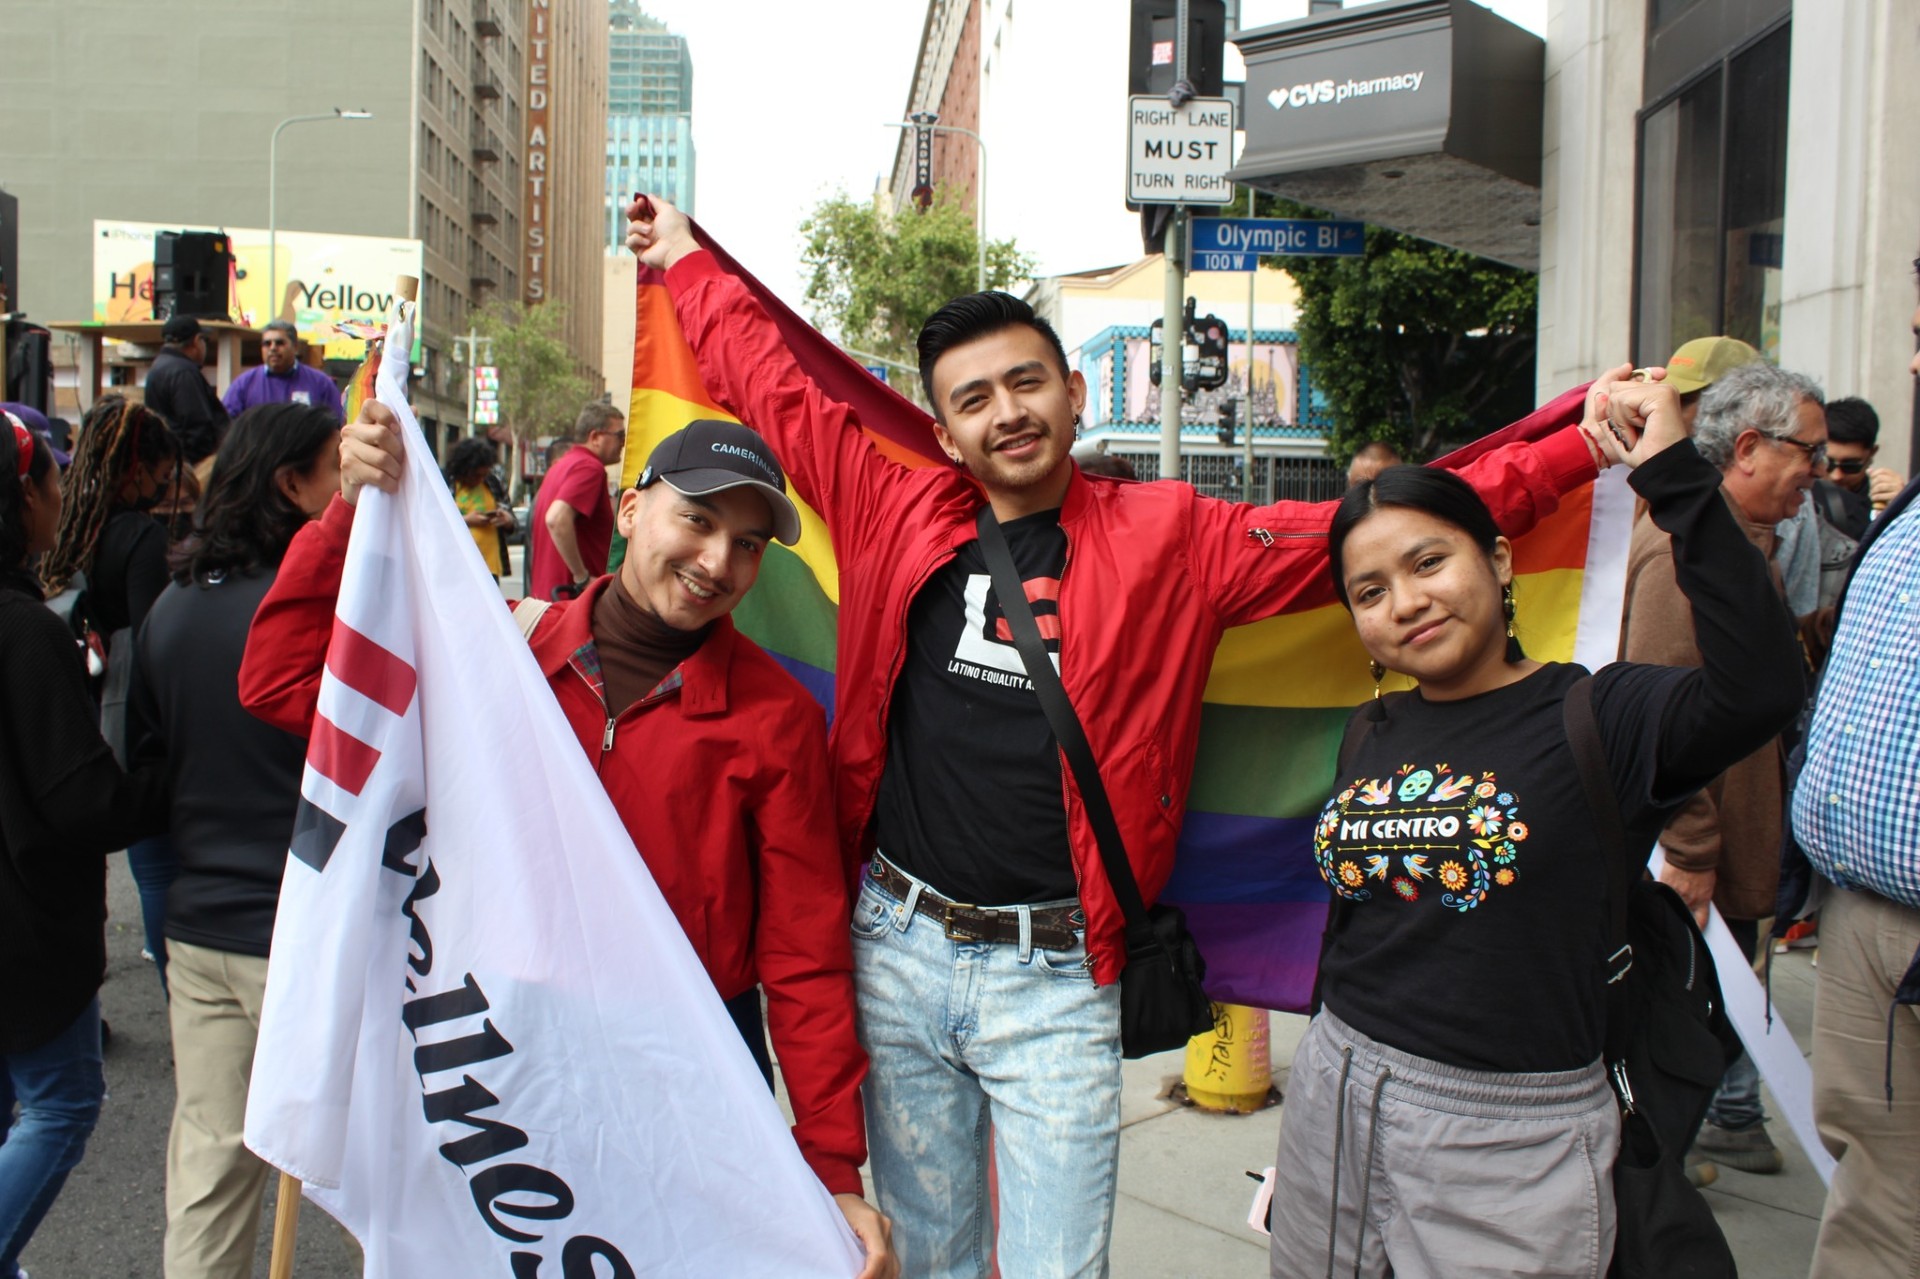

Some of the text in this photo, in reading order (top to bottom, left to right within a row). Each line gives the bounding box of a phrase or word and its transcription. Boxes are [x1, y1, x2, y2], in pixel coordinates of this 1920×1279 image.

[1289, 71, 1424, 107] CVS pharmacy
[1134, 111, 1229, 127] RIGHT LANE
[1145, 140, 1218, 160] MUST
[1134, 173, 1227, 189] TURN RIGHT
[528, 126, 546, 299] ARTISTS
[1217, 223, 1338, 252] Olympic Bl
[1205, 254, 1244, 269] 100 W
[947, 660, 980, 679] LATINO
[981, 670, 1025, 689] EQUALITY
[1340, 816, 1460, 840] MI CENTRO
